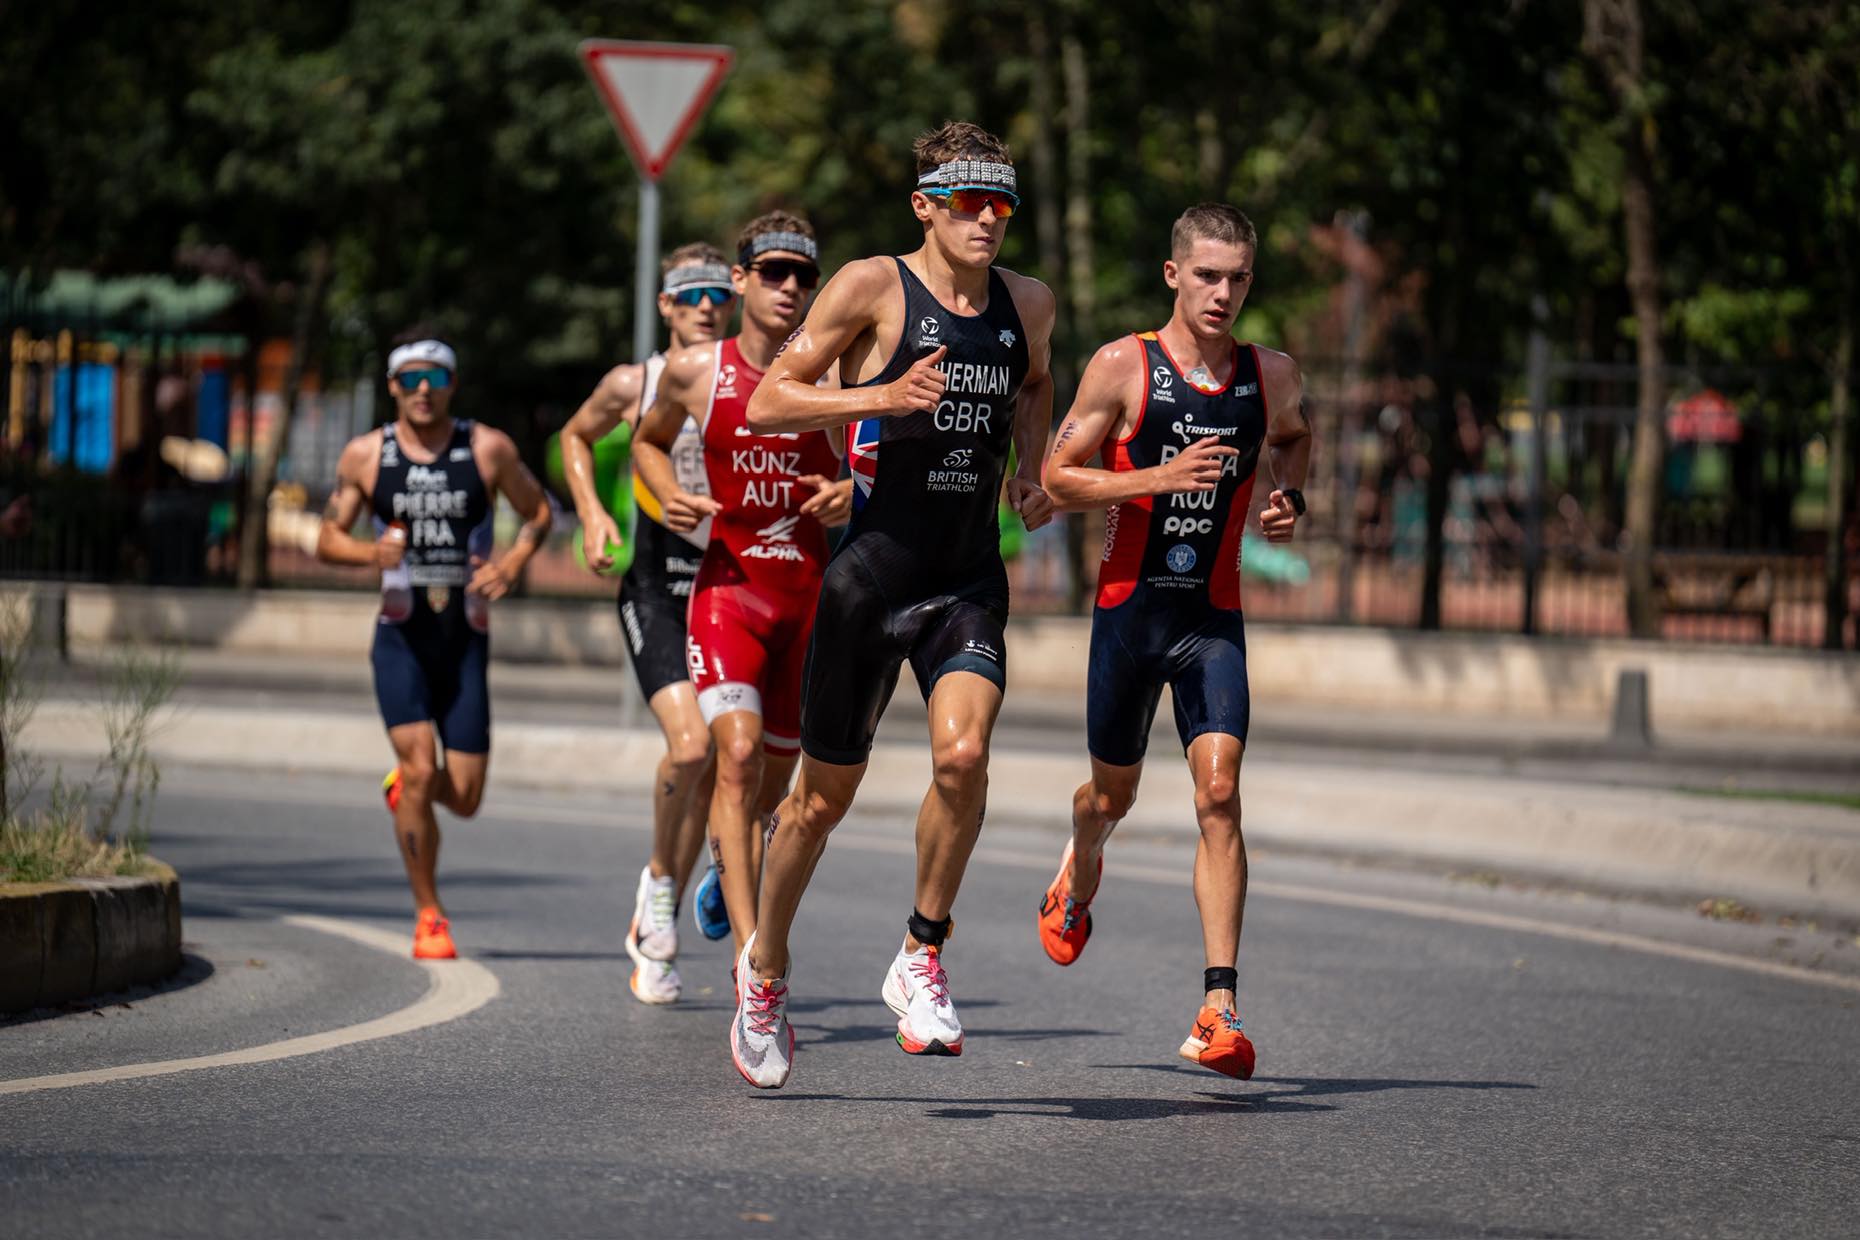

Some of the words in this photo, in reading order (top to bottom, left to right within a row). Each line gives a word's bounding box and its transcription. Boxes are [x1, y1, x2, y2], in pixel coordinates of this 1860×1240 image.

[935, 361, 1009, 395] HERMAN
[1153, 393, 1175, 403] Triathlon
[1156, 388, 1172, 396] World
[934, 400, 991, 434] GBR
[1185, 424, 1238, 436] TRISPORT
[732, 445, 801, 475] KÜNZ
[926, 482, 976, 493] TRIATHLON
[928, 470, 978, 484] BRITISH
[742, 480, 794, 509] AUT
[412, 519, 456, 546] FRA
[1162, 515, 1214, 538] ppc
